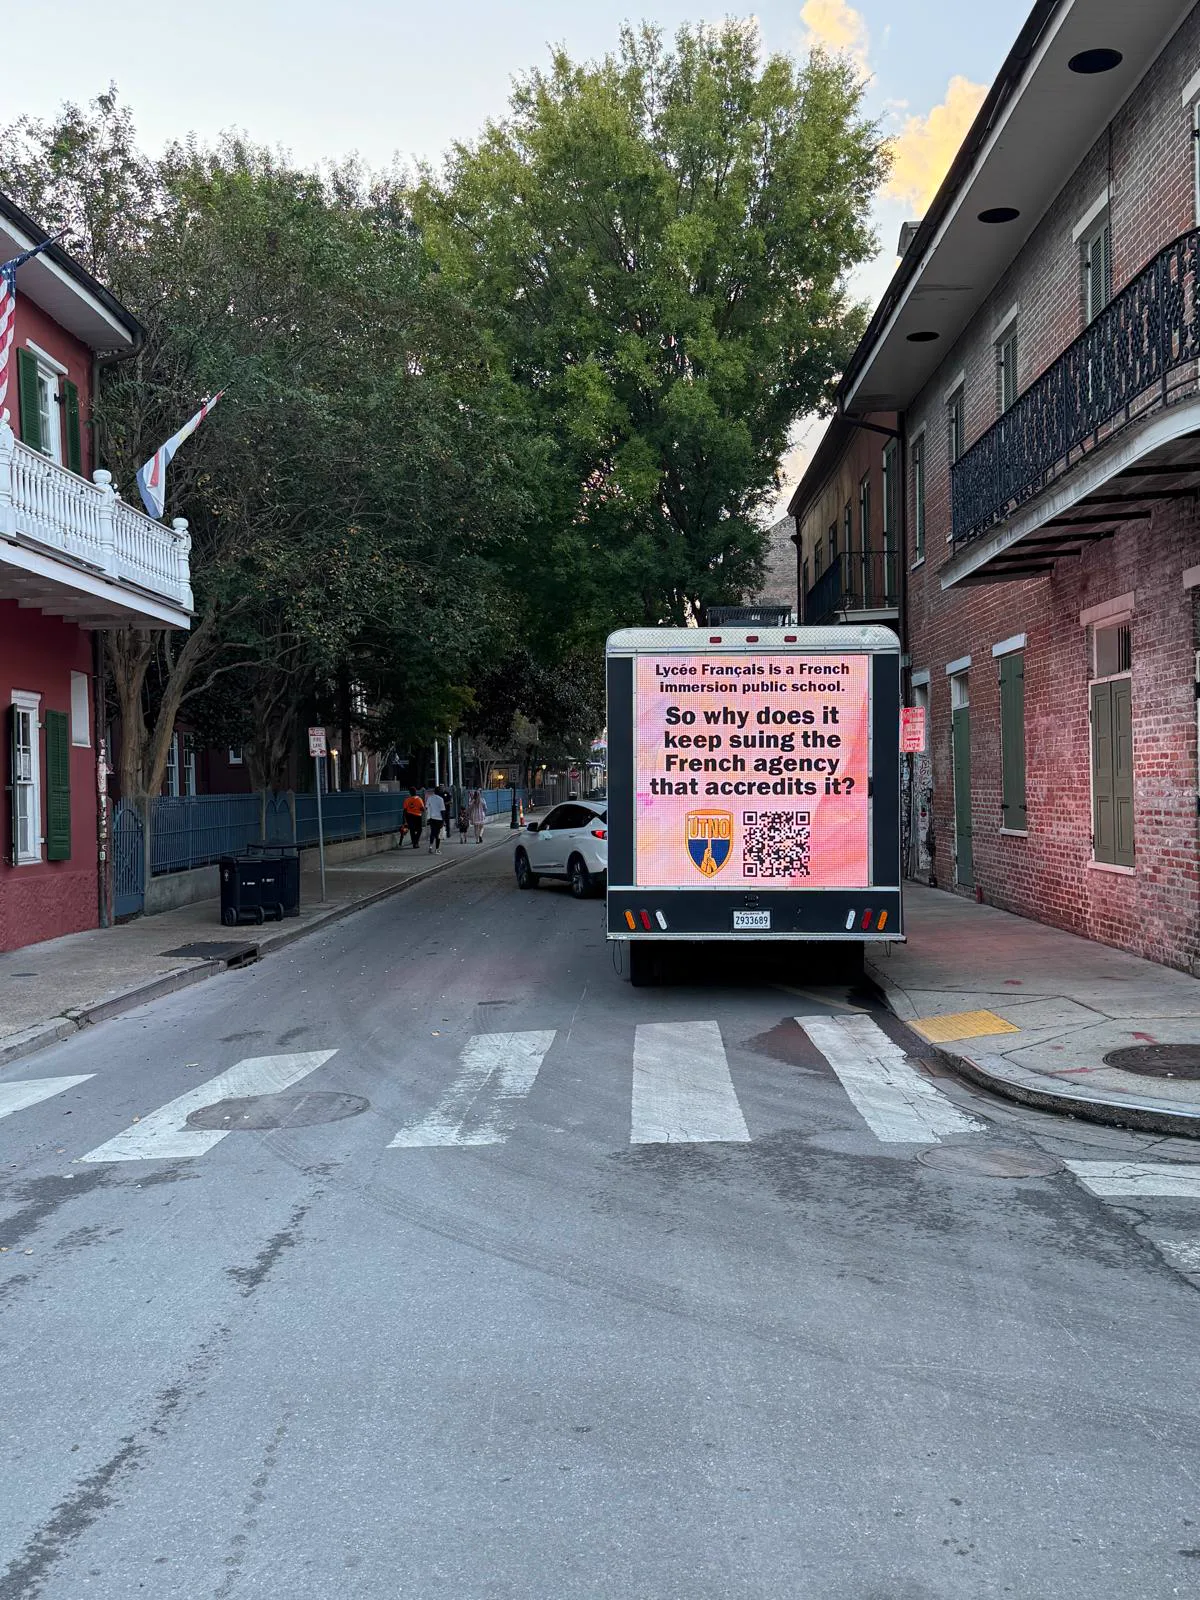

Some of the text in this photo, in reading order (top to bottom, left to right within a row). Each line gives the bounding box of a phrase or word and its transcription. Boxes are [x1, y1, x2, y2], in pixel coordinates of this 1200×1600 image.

[655, 663, 850, 679] Lycée Français is a French
[660, 680, 846, 694] immersion public school.
[665, 705, 840, 730] So why does it
[664, 730, 842, 753] keep suing the
[665, 754, 841, 776] French agency
[649, 776, 856, 796] that accredits it?
[688, 817, 731, 838] UTNO
